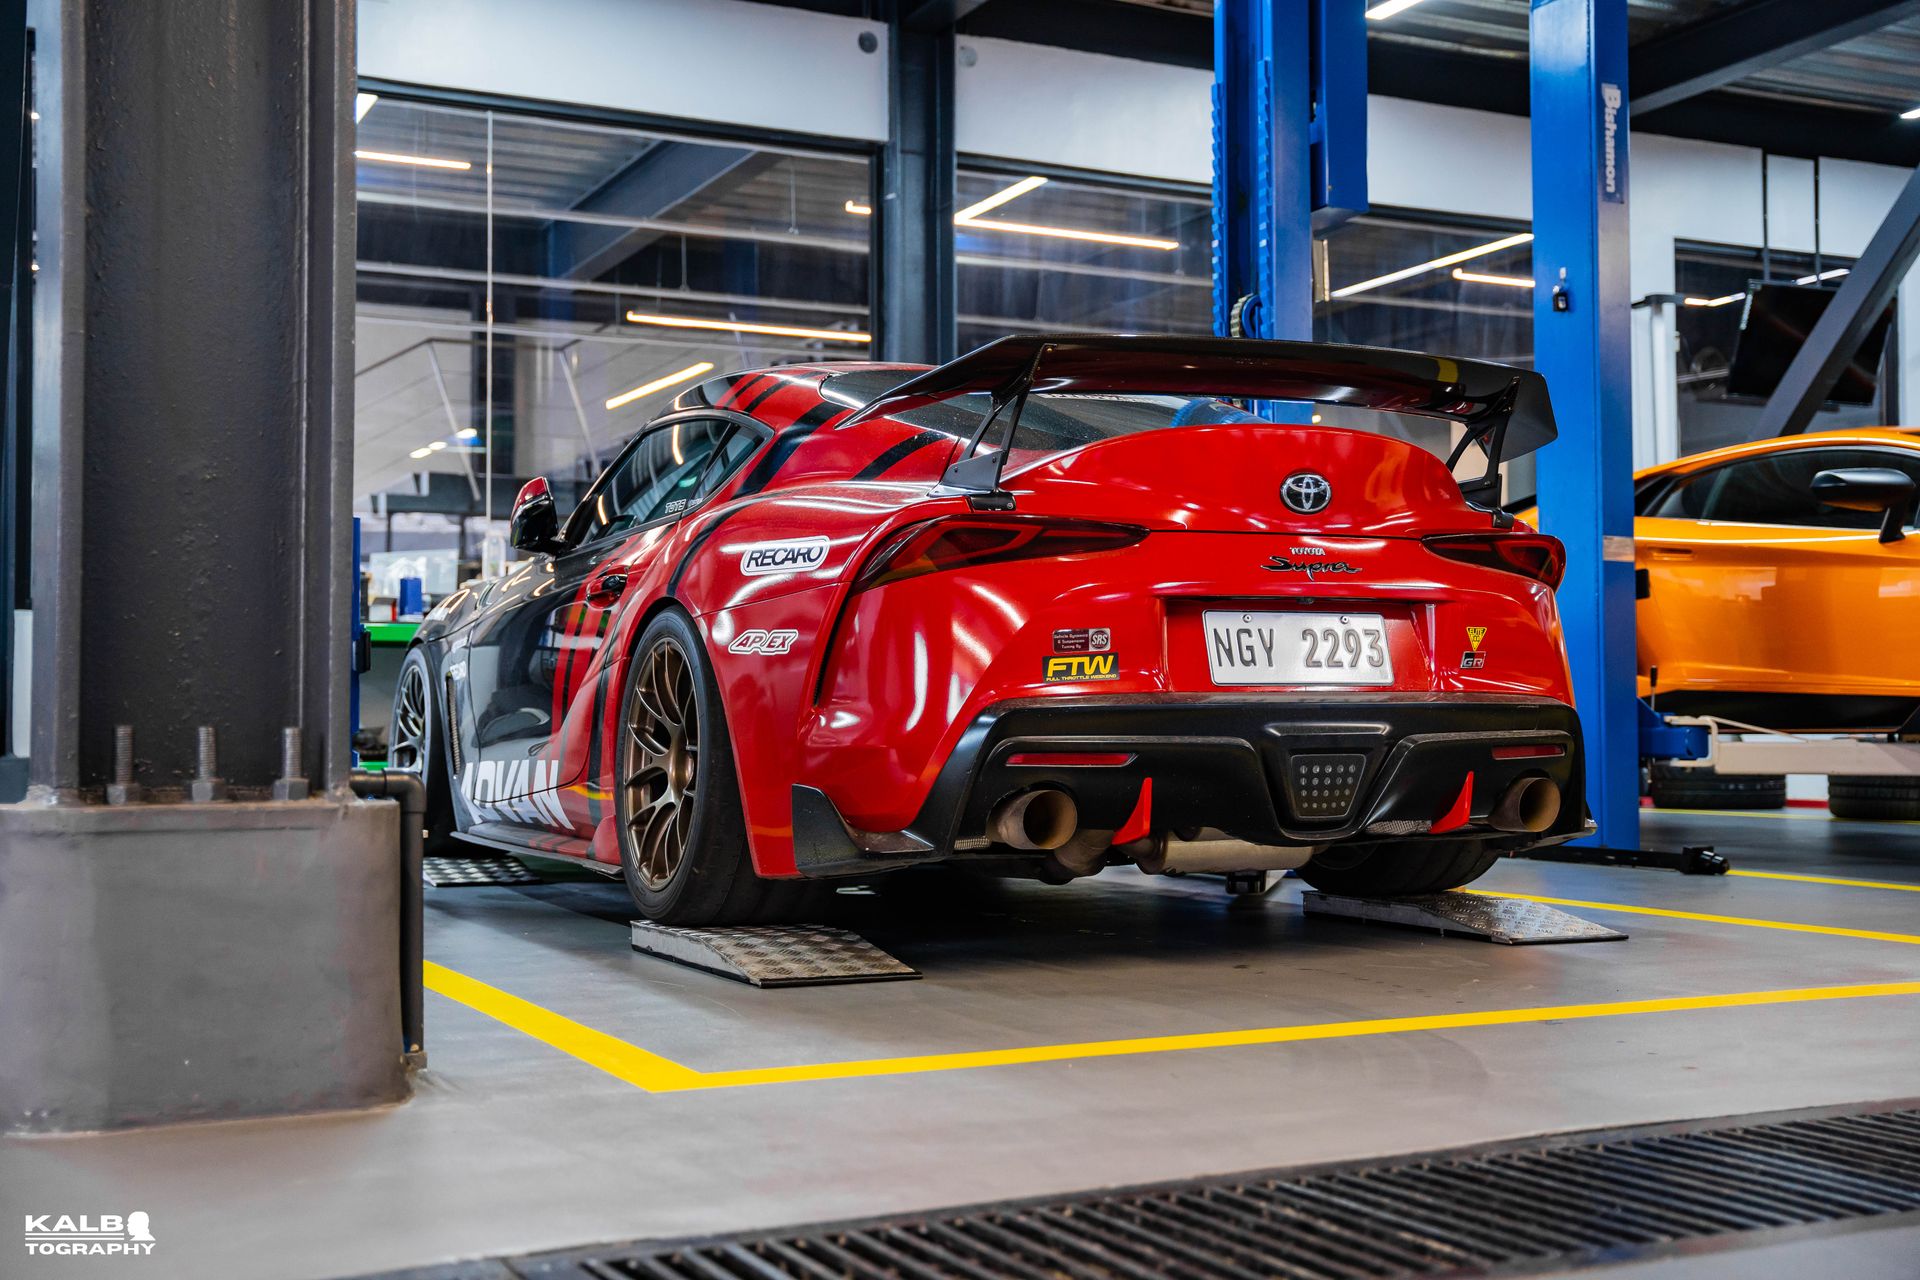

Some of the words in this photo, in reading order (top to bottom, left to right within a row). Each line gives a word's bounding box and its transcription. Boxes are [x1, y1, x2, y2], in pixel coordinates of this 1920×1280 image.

[1601, 83, 1621, 193] Bishamon
[747, 546, 824, 569] RECARO
[1290, 547, 1326, 556] TOYOTA
[1260, 556, 1363, 581] Supra
[1092, 634, 1108, 645] SRS
[1213, 628, 1274, 667] NGY
[1302, 628, 1384, 668] 2293
[1047, 655, 1114, 677] FTW
[1464, 658, 1483, 666] GR
[461, 760, 575, 830] ADVAN
